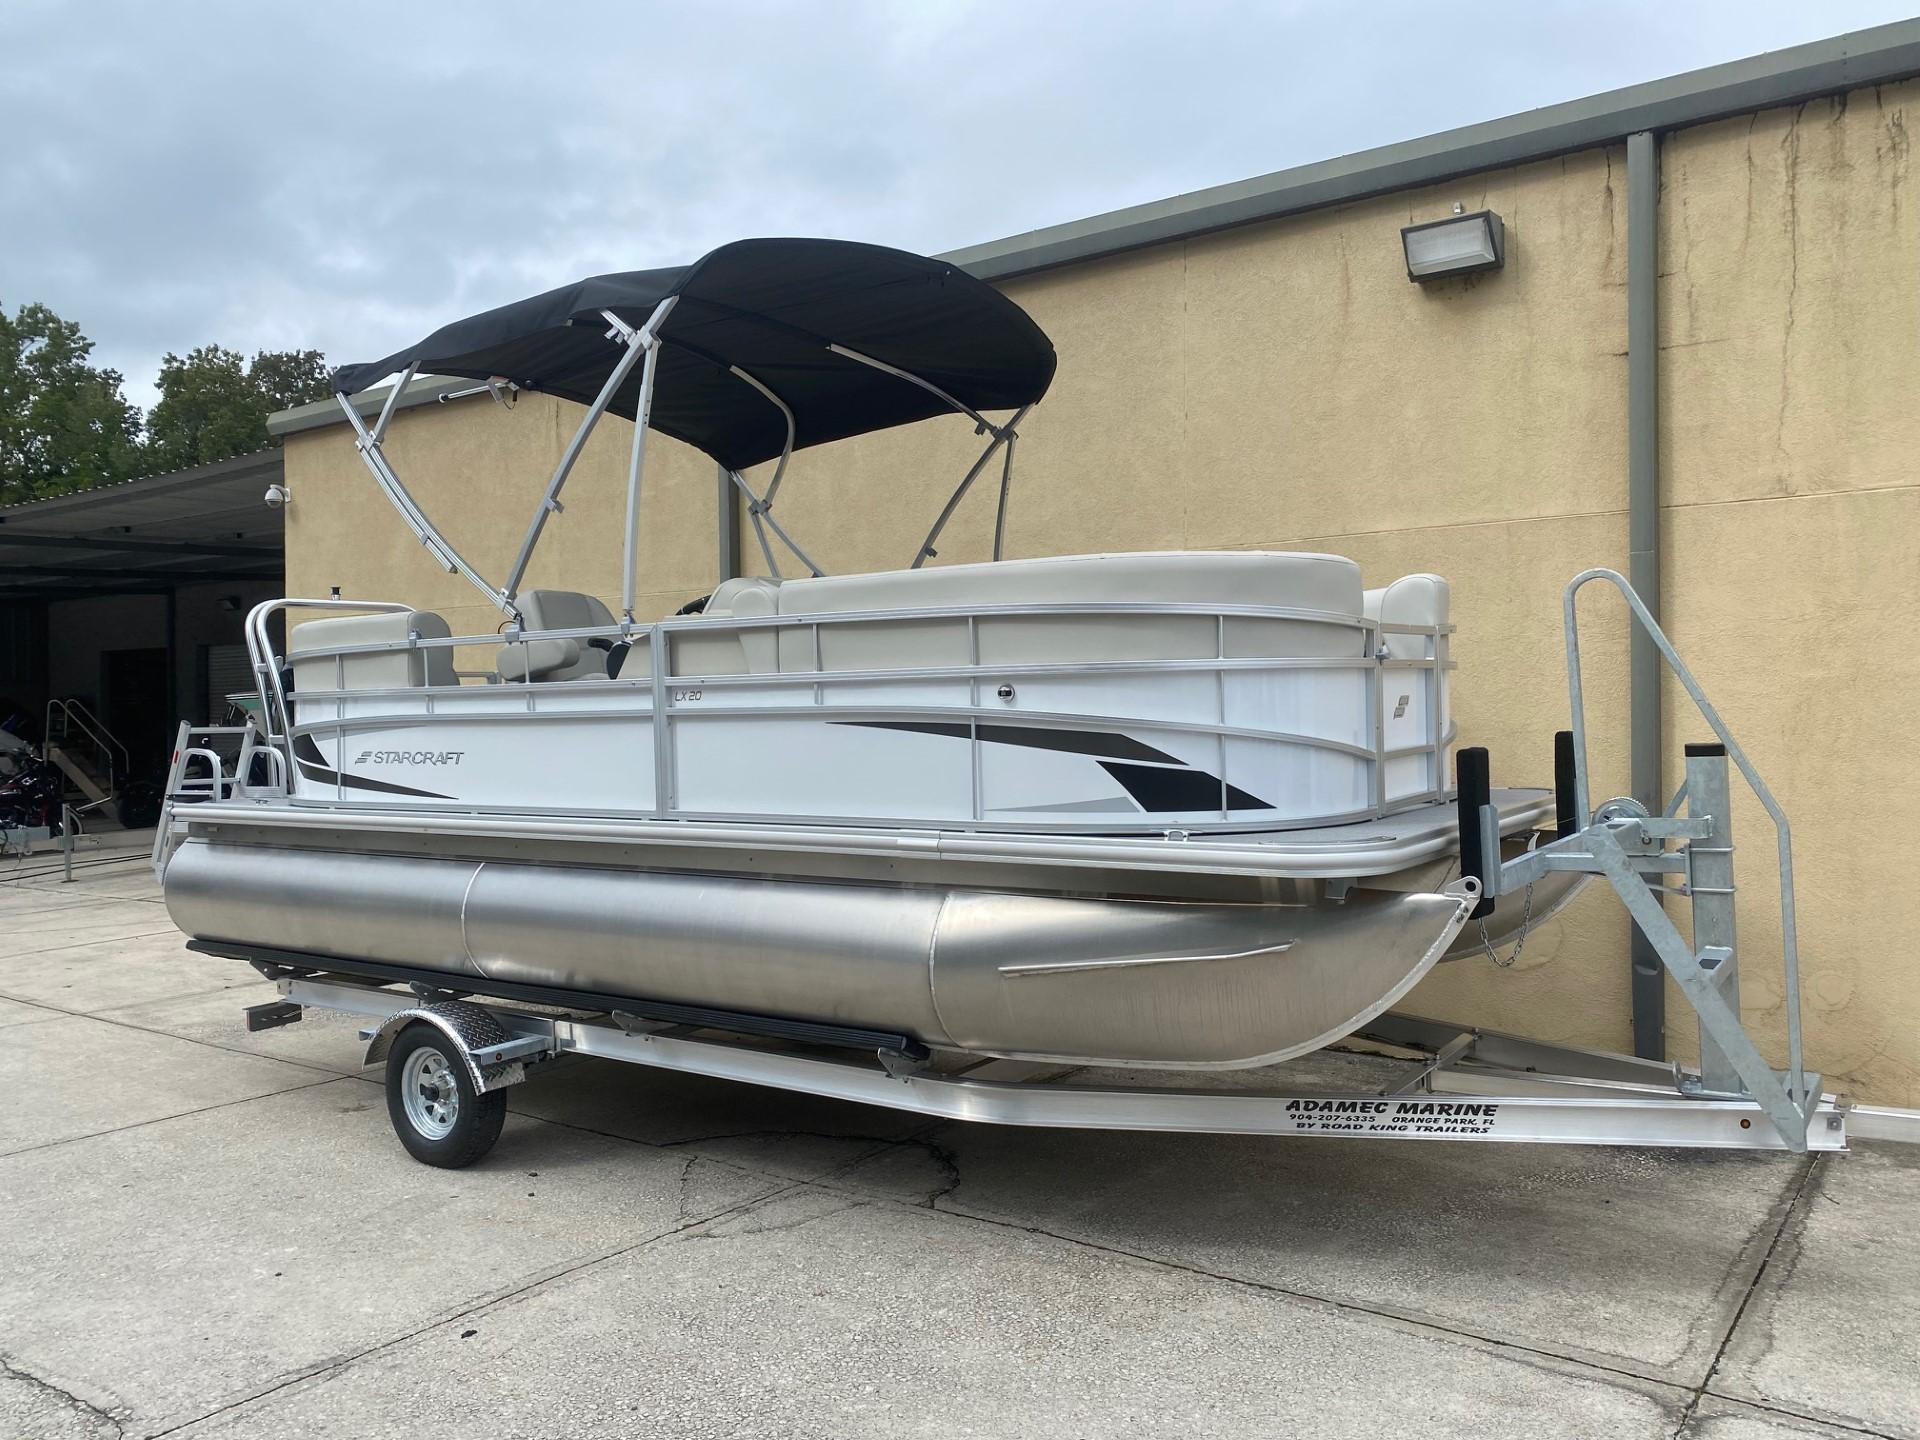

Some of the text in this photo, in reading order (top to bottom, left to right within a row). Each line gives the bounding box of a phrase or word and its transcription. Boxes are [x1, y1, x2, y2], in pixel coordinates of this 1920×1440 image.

[675, 690, 702, 701] LX 20
[373, 751, 464, 766] STARCRAFT
[1285, 1100, 1499, 1117] ADAMEC MARINE
[1289, 1113, 1377, 1123] 904-207-6335
[1391, 1116, 1441, 1124] ORANGE
[1444, 1118, 1478, 1126] PARK,
[1369, 1124, 1409, 1132] KING
[1415, 1125, 1491, 1134] TRAILERS
